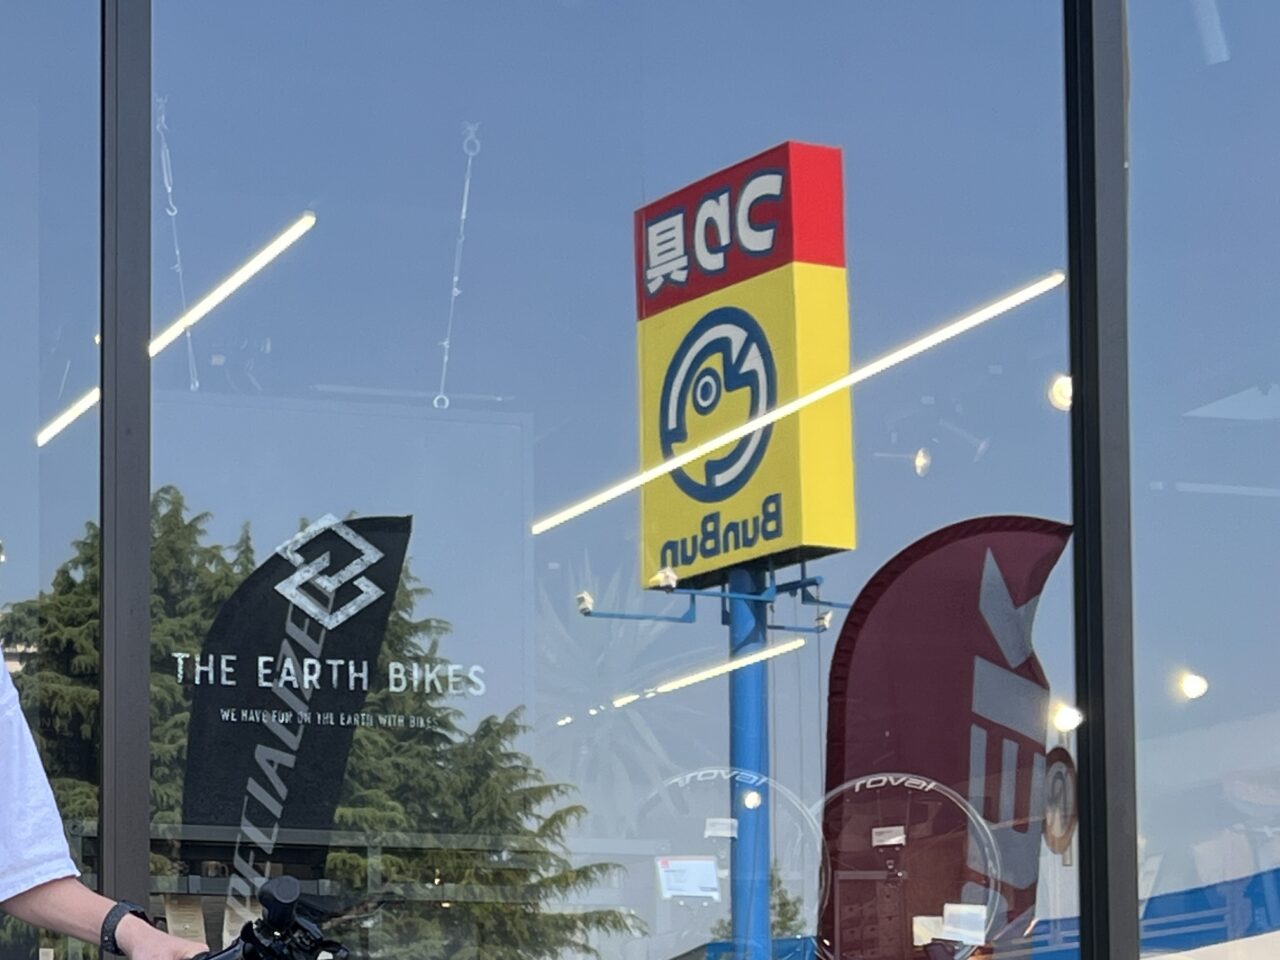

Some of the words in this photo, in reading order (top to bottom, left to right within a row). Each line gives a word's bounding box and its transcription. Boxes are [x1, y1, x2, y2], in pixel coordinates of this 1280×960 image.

[171, 653, 238, 686] THE
[257, 656, 368, 690] EARTH
[388, 661, 486, 697] BIKES
[225, 577, 336, 935] PECIALIZE
[854, 776, 937, 793] roval
